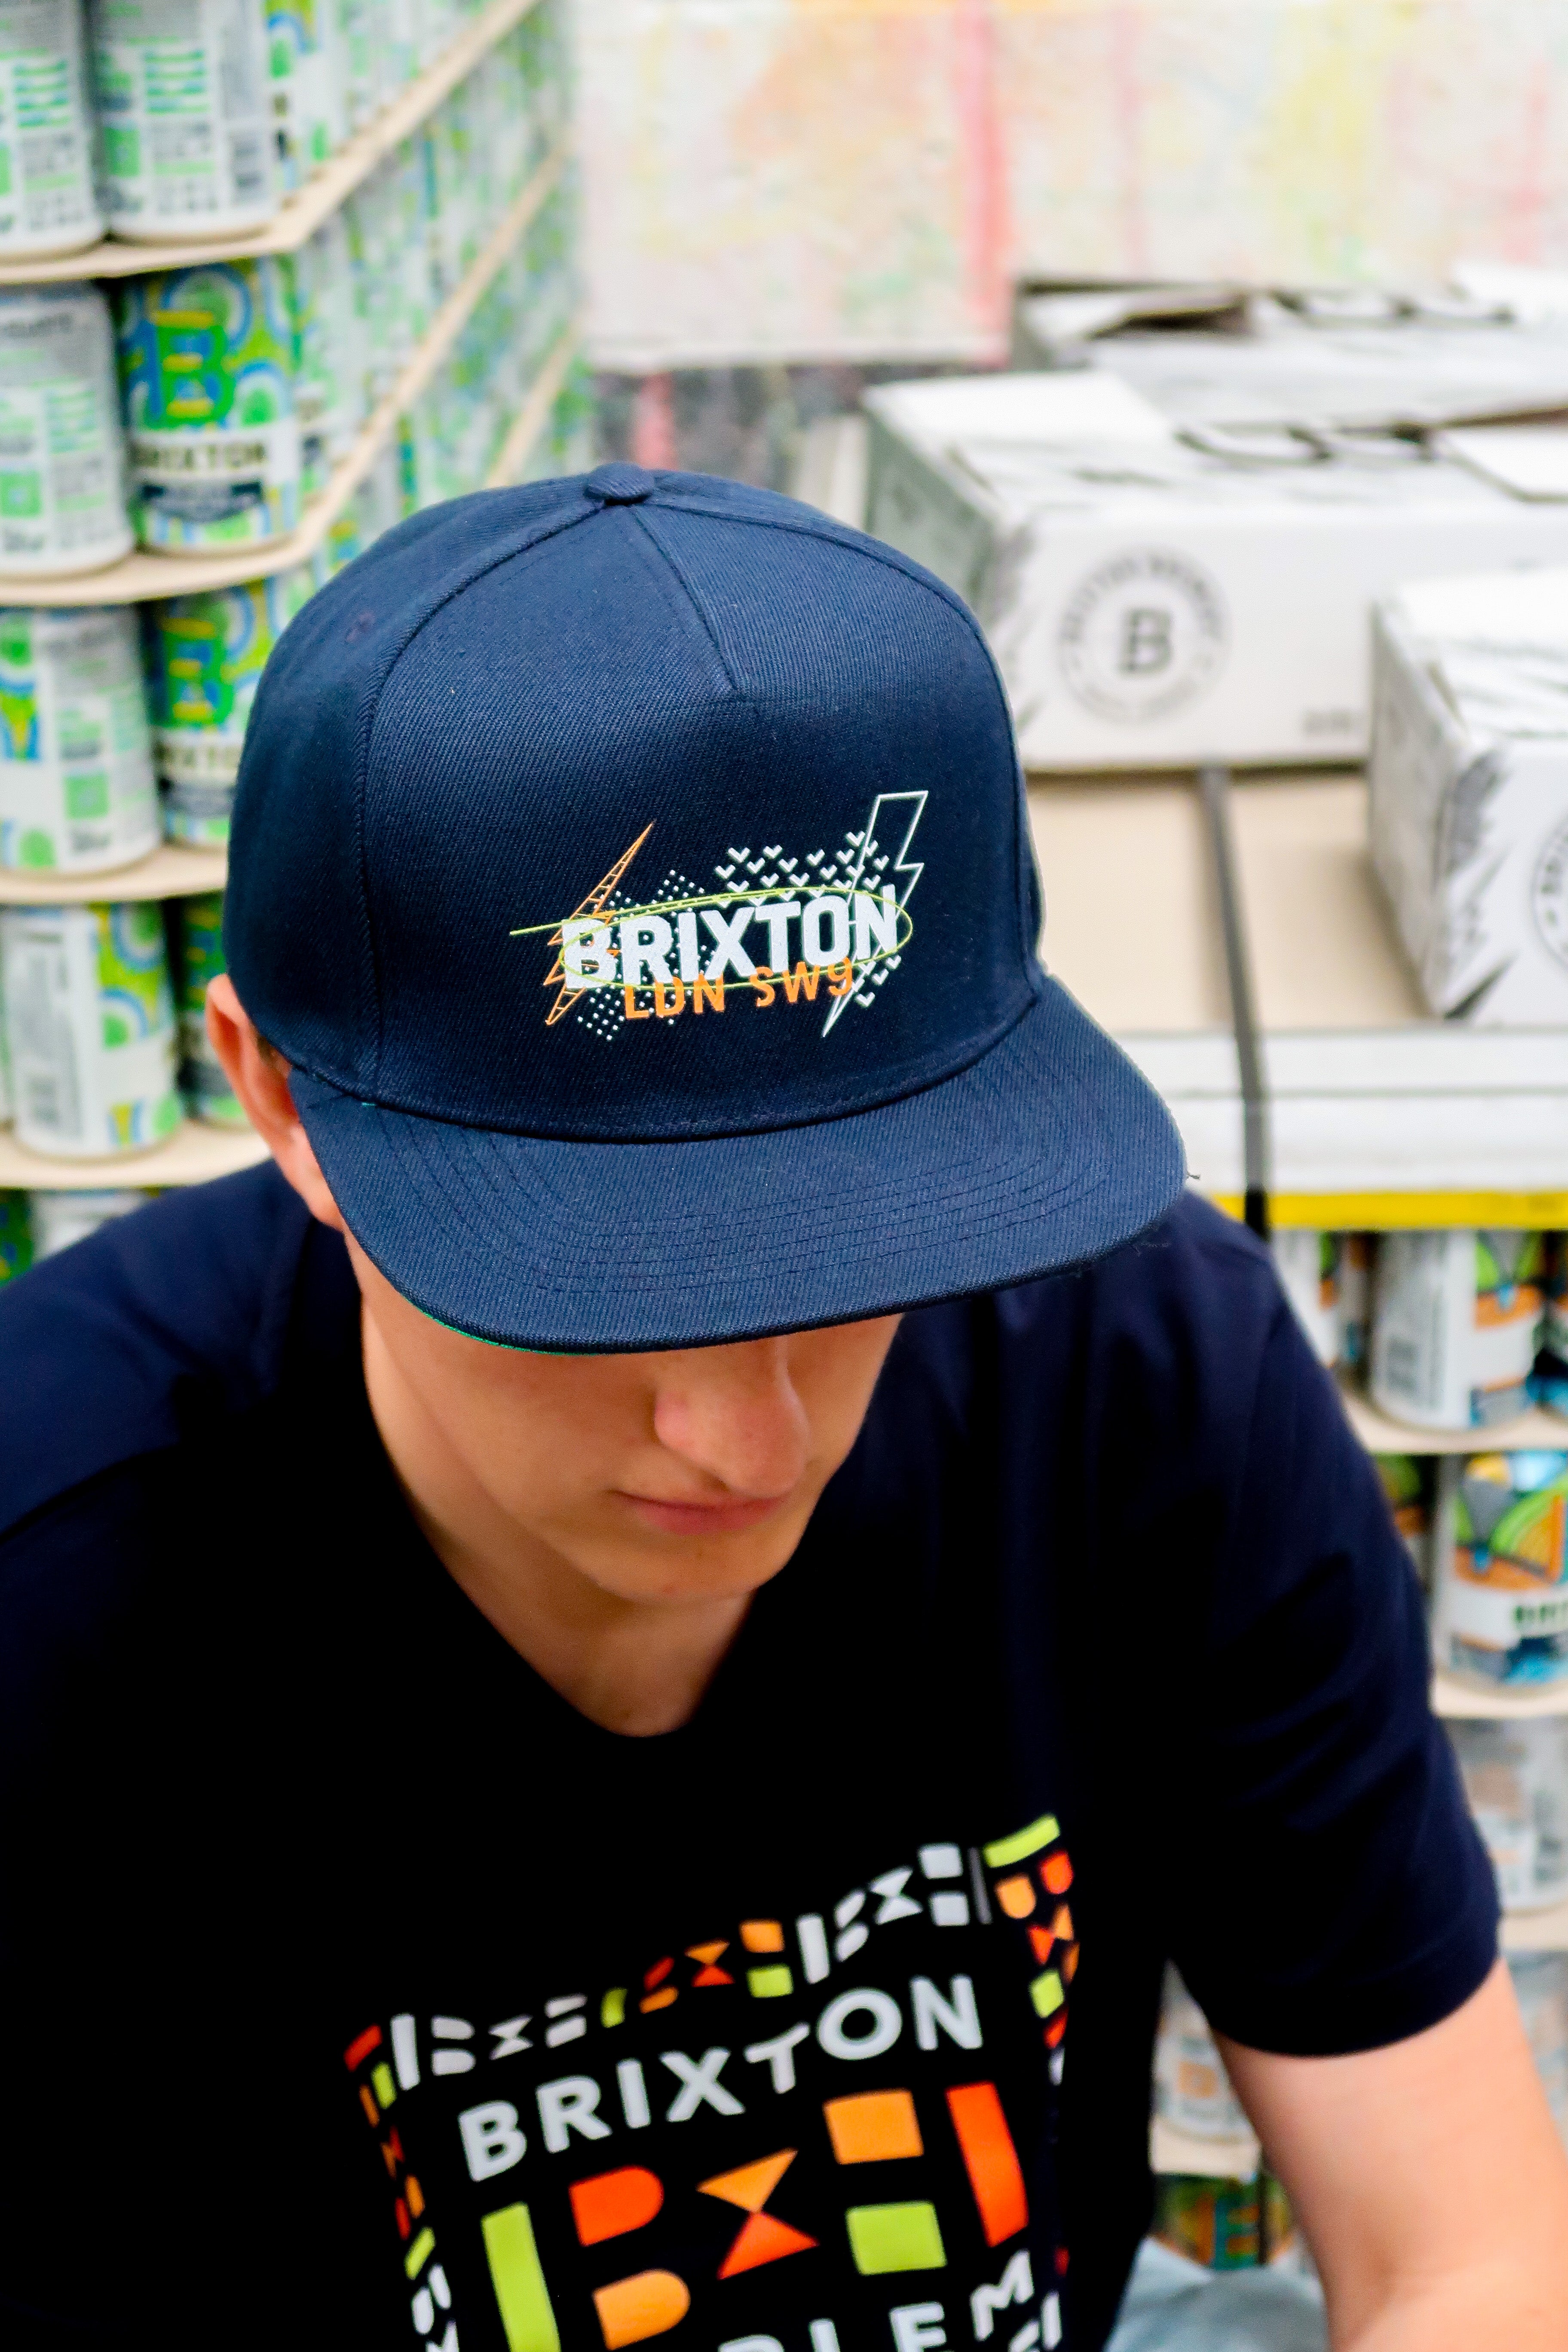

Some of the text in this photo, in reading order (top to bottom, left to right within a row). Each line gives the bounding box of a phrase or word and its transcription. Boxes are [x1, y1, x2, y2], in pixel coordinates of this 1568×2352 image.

[561, 884, 897, 990] BRIXTON
[624, 957, 854, 1020] LDN SW9
[458, 1974, 983, 2182] BRIXTON
